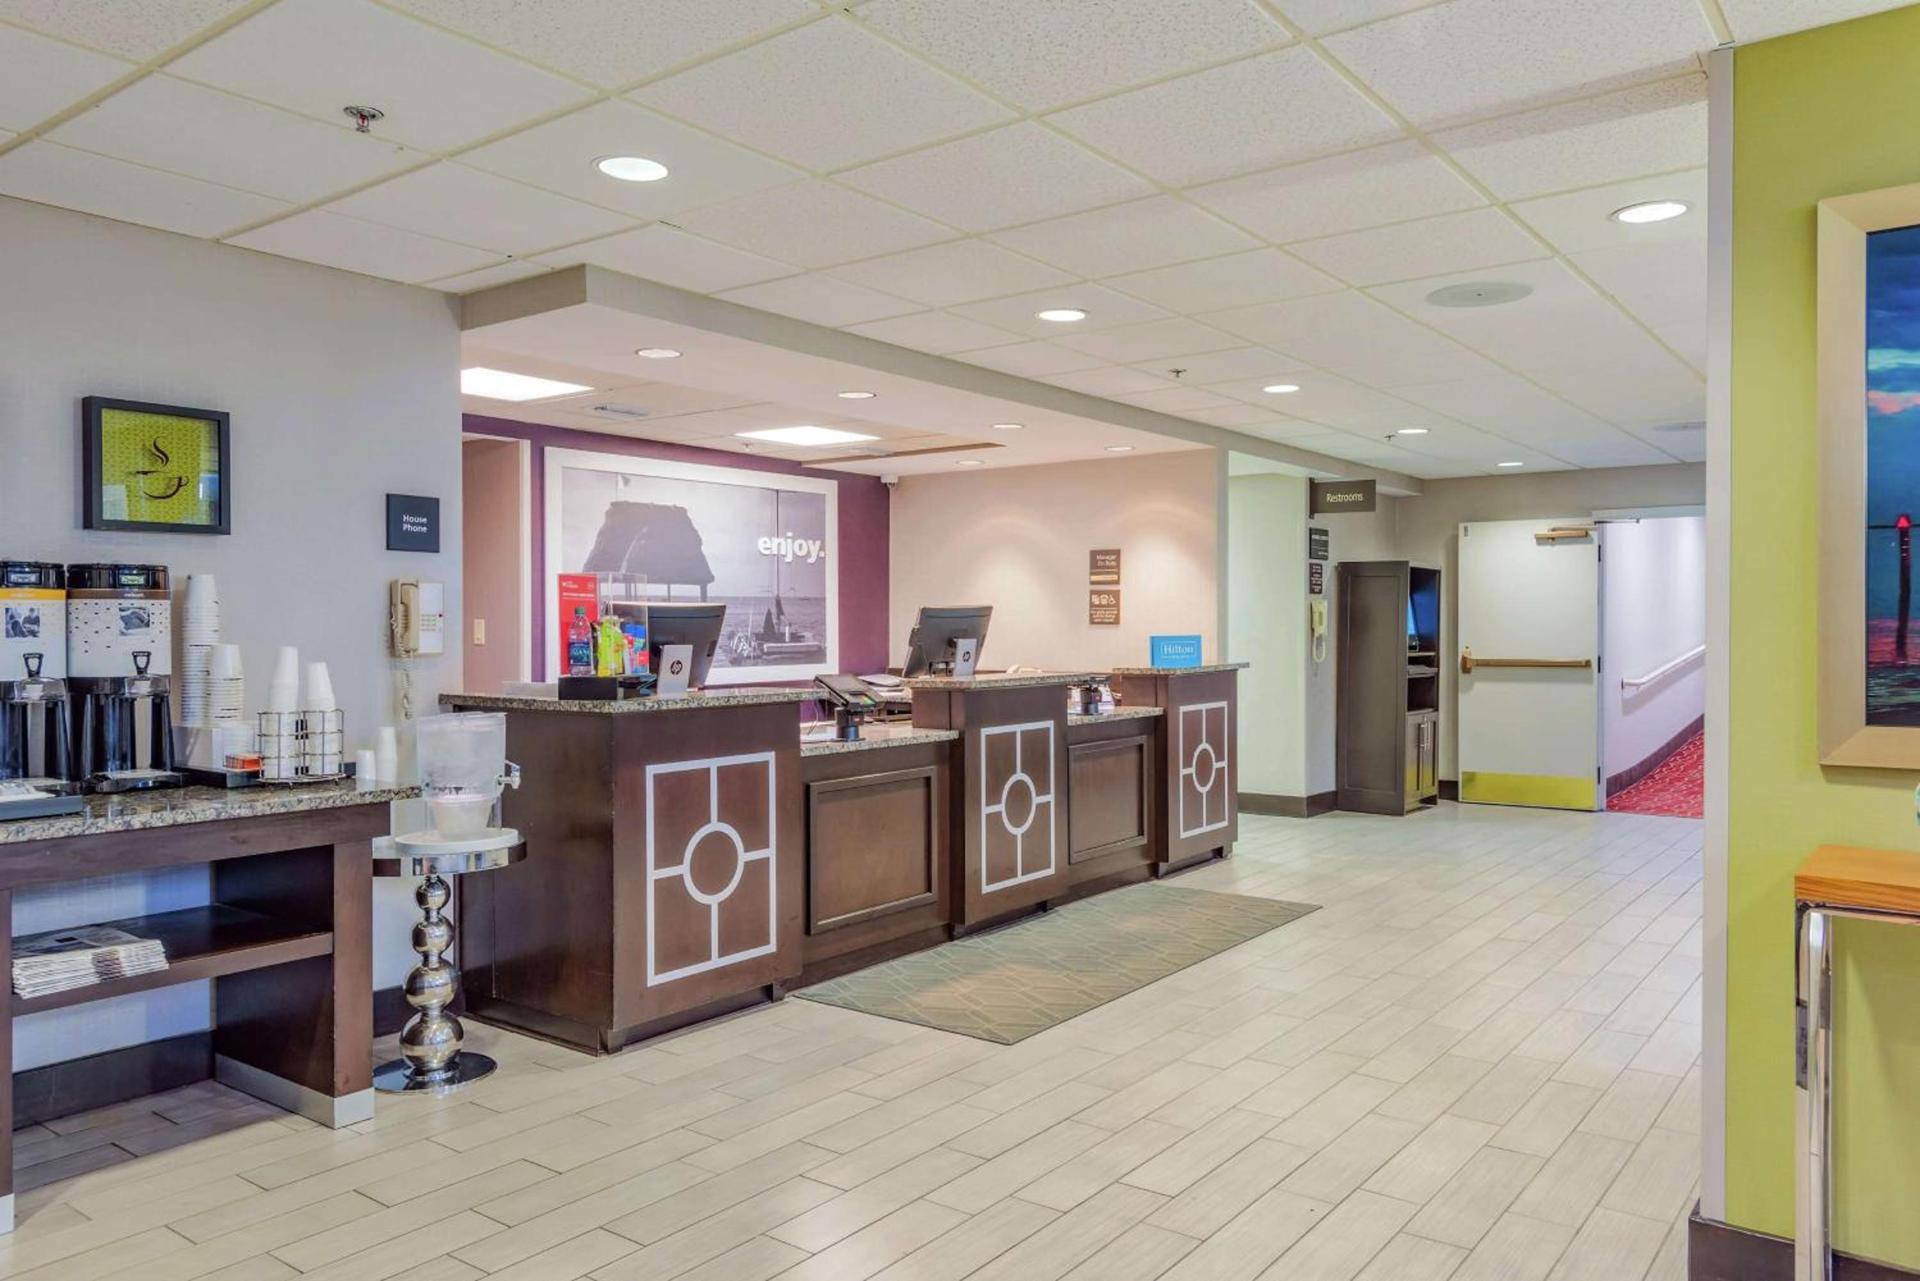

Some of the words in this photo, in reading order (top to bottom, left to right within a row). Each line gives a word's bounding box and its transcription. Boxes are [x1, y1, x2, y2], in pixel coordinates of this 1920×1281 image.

[1326, 493, 1363, 503] Restrooms
[402, 514, 428, 524] House
[402, 523, 428, 533] Phone
[757, 531, 825, 564] enjoy.
[1163, 644, 1194, 656] Hilton
